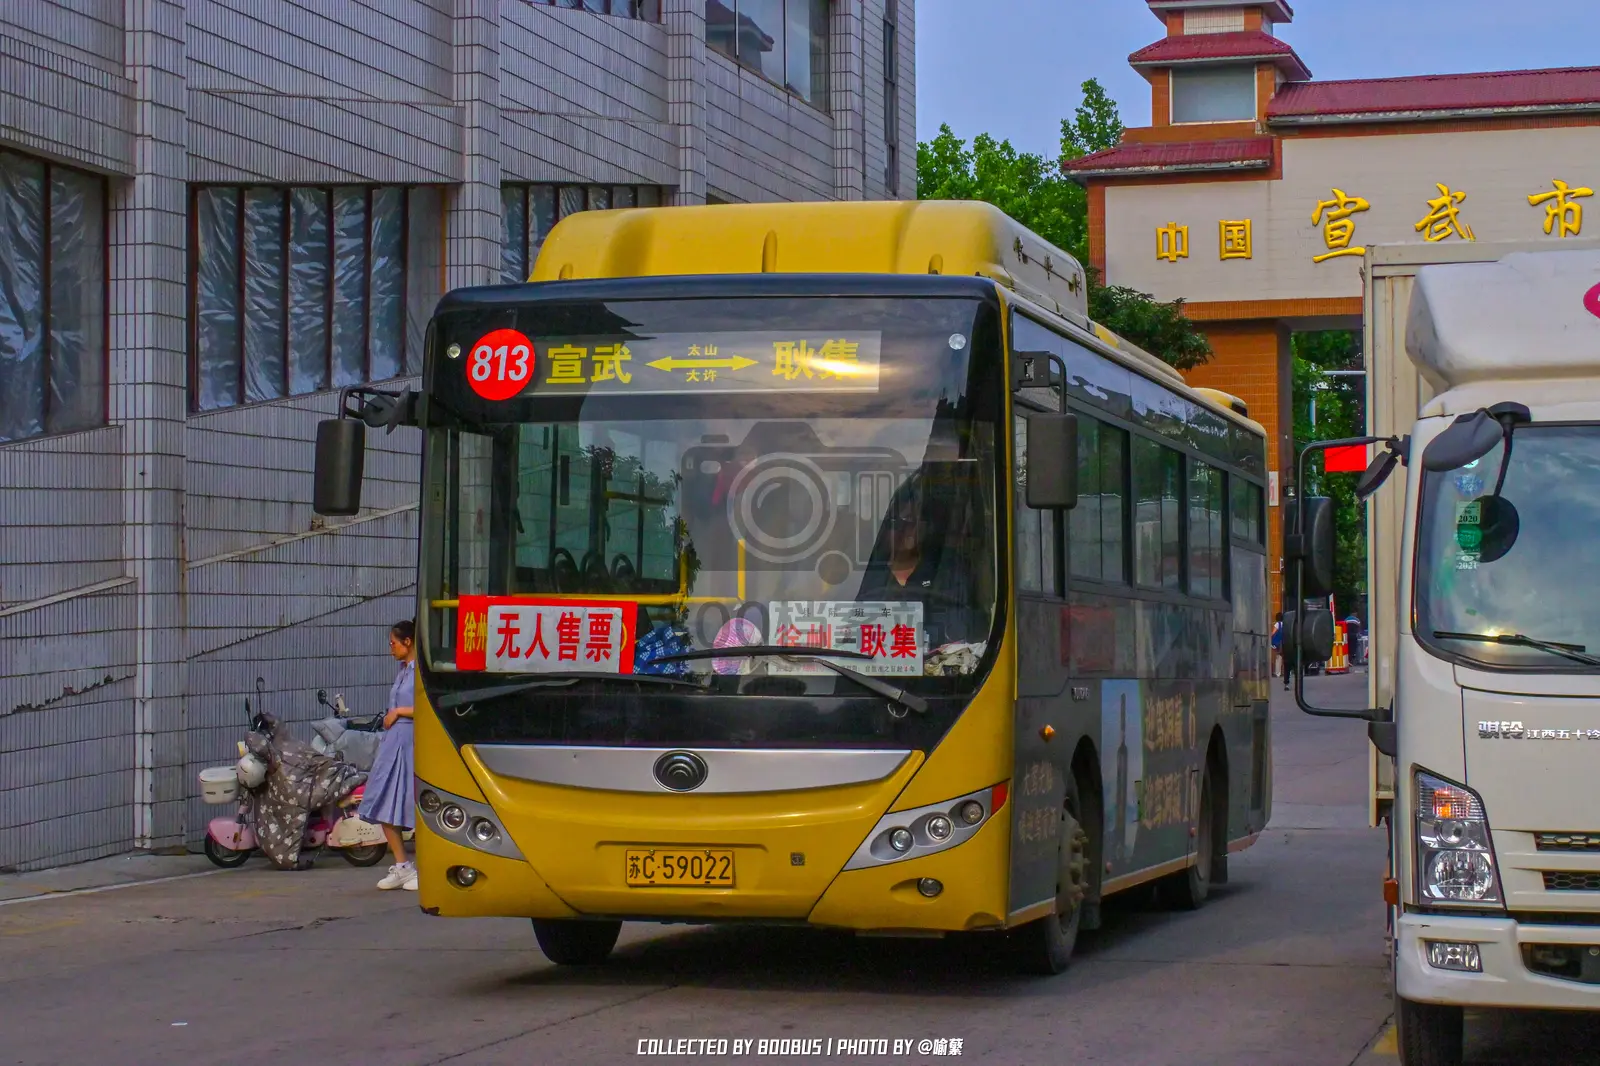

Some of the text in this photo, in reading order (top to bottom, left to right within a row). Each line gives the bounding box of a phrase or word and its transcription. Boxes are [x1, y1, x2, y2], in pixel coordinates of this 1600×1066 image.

[1156, 178, 1595, 263] 中国 宣武市
[471, 343, 530, 382] 813
[546, 343, 632, 385] 宣武
[687, 343, 718, 357] 太山
[772, 339, 860, 382] 耿集
[685, 368, 718, 383] 大许
[495, 611, 614, 663] 无人售票
[859, 623, 917, 659] 耿集
